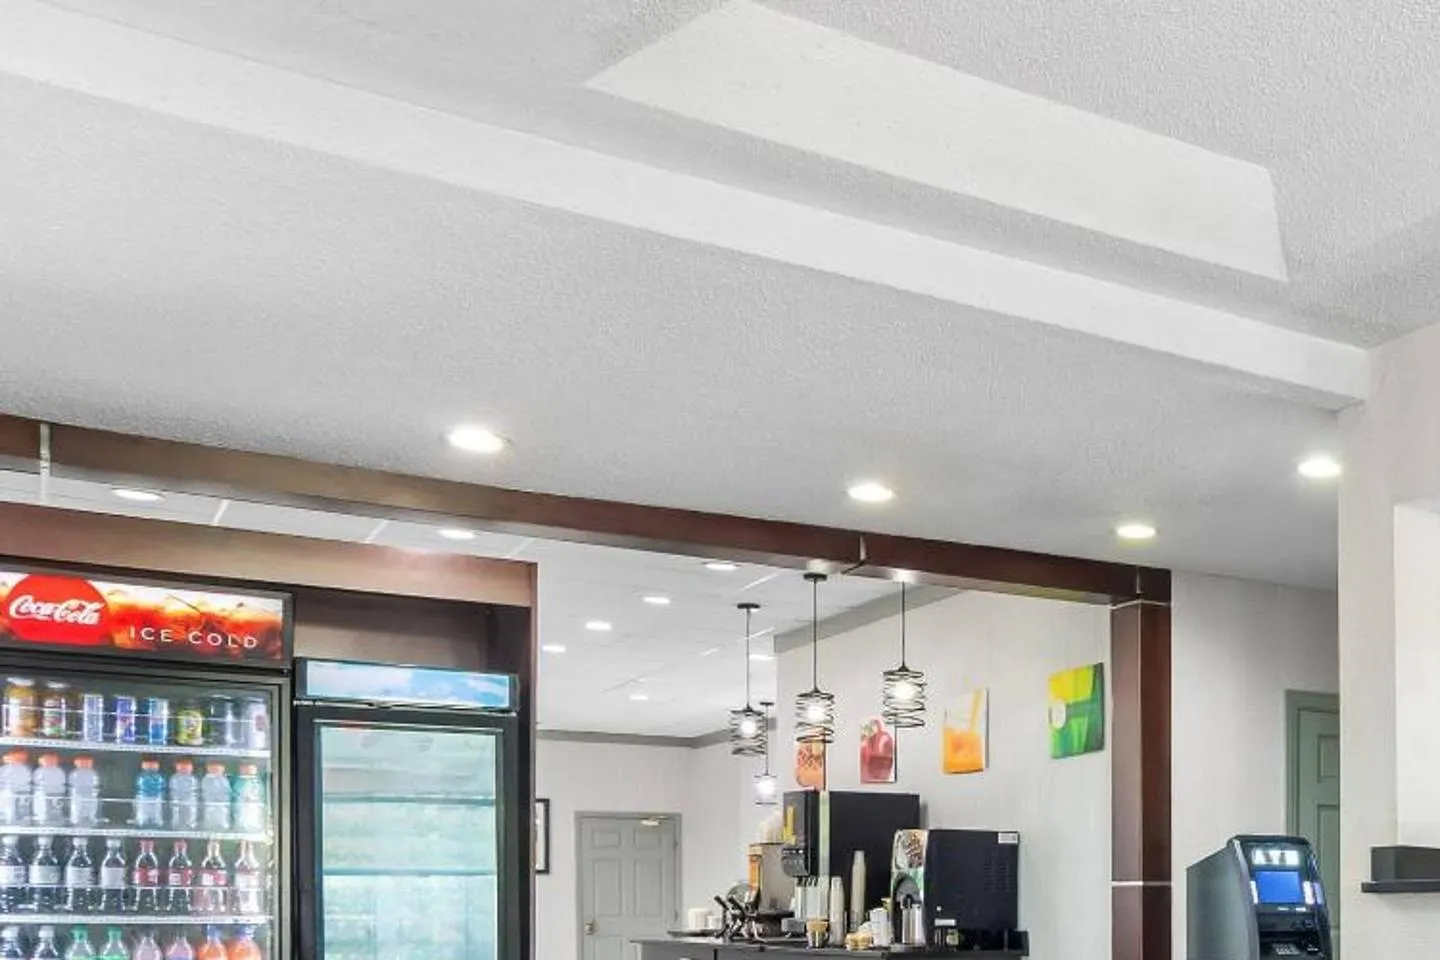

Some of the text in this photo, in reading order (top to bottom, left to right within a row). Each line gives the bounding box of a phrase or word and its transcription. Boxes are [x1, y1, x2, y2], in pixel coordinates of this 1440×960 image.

[9, 595, 105, 625] Coca-Cola
[129, 625, 258, 648] ICE COLD
